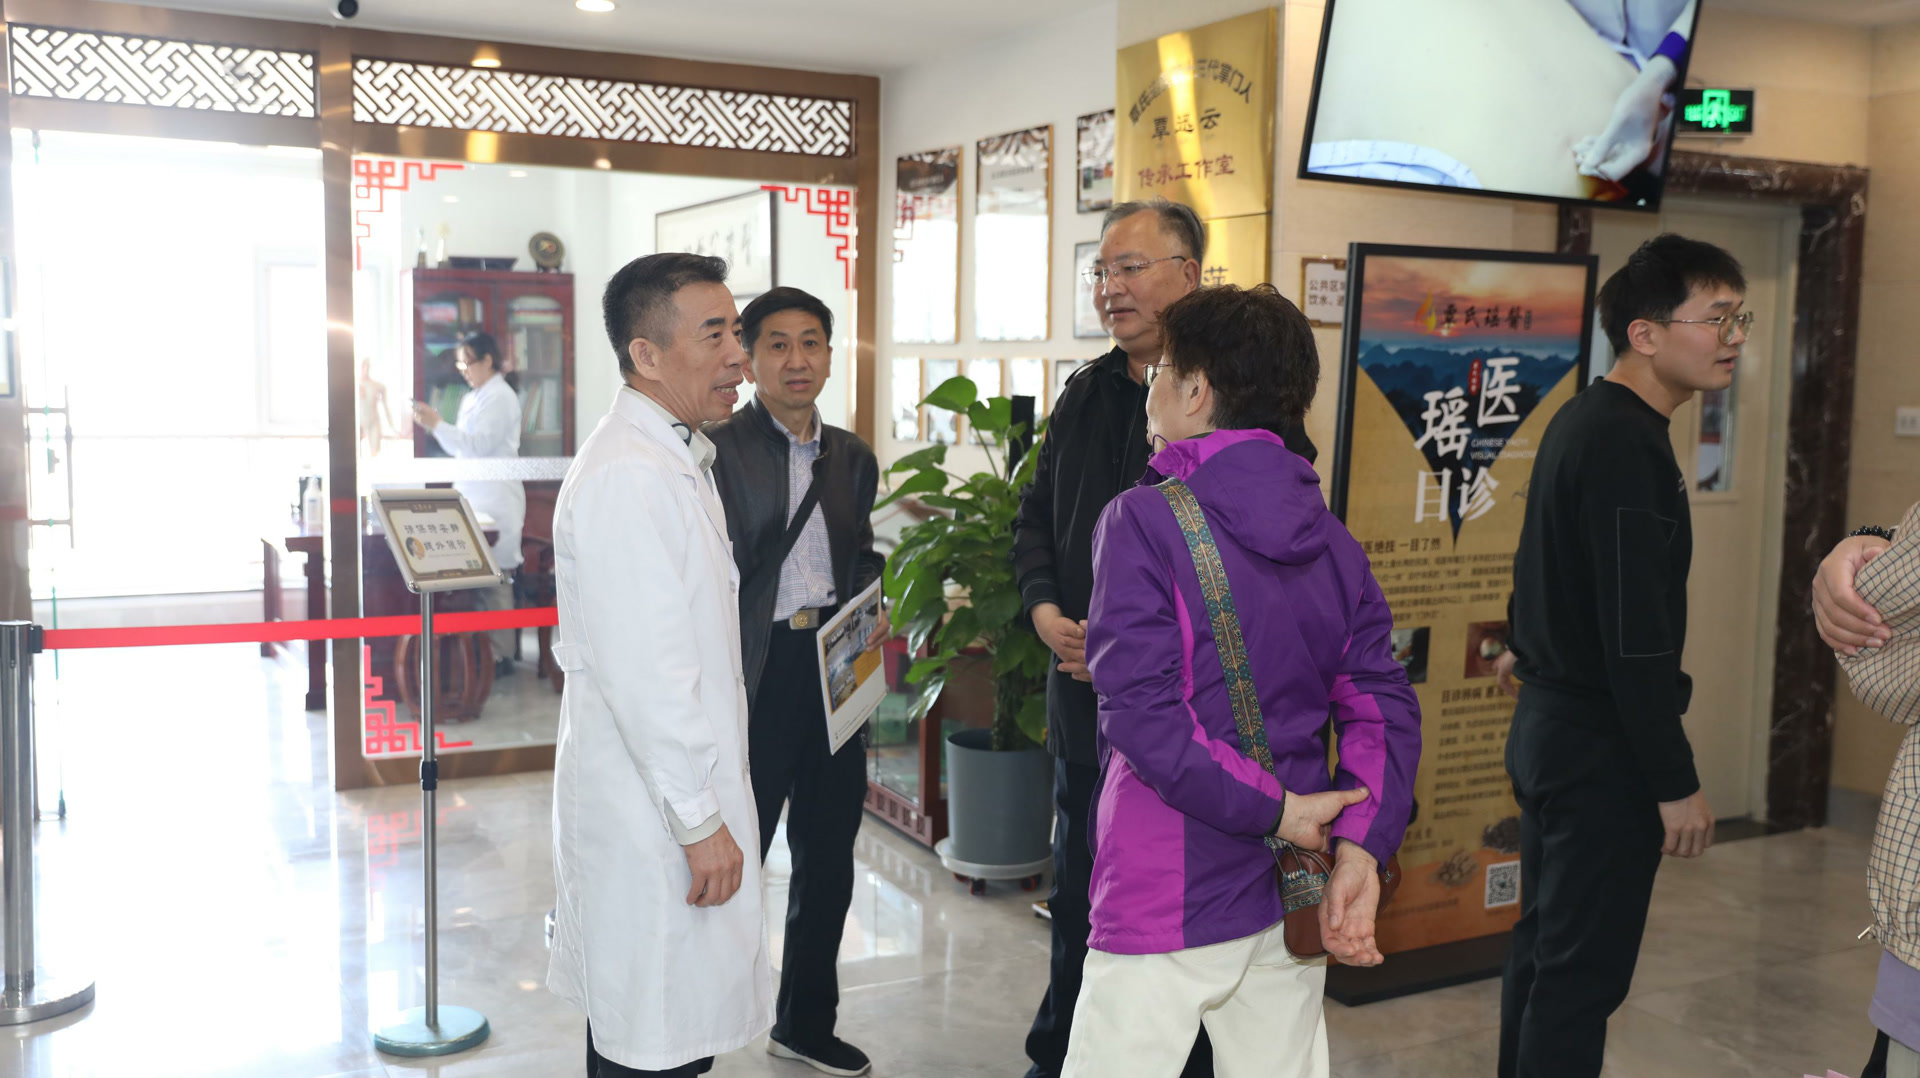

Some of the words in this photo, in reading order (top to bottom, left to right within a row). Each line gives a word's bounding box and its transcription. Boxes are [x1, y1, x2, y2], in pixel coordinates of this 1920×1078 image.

[1138, 154, 1235, 189] 传承工作室
[1471, 438, 1503, 448] CHINESE
[1470, 451, 1497, 461] VISUAL
[1414, 466, 1500, 524] 目诊
[404, 523, 460, 535] 请保持安静
[1360, 540, 1396, 554] 医绝技
[1400, 537, 1441, 553] 一目了然
